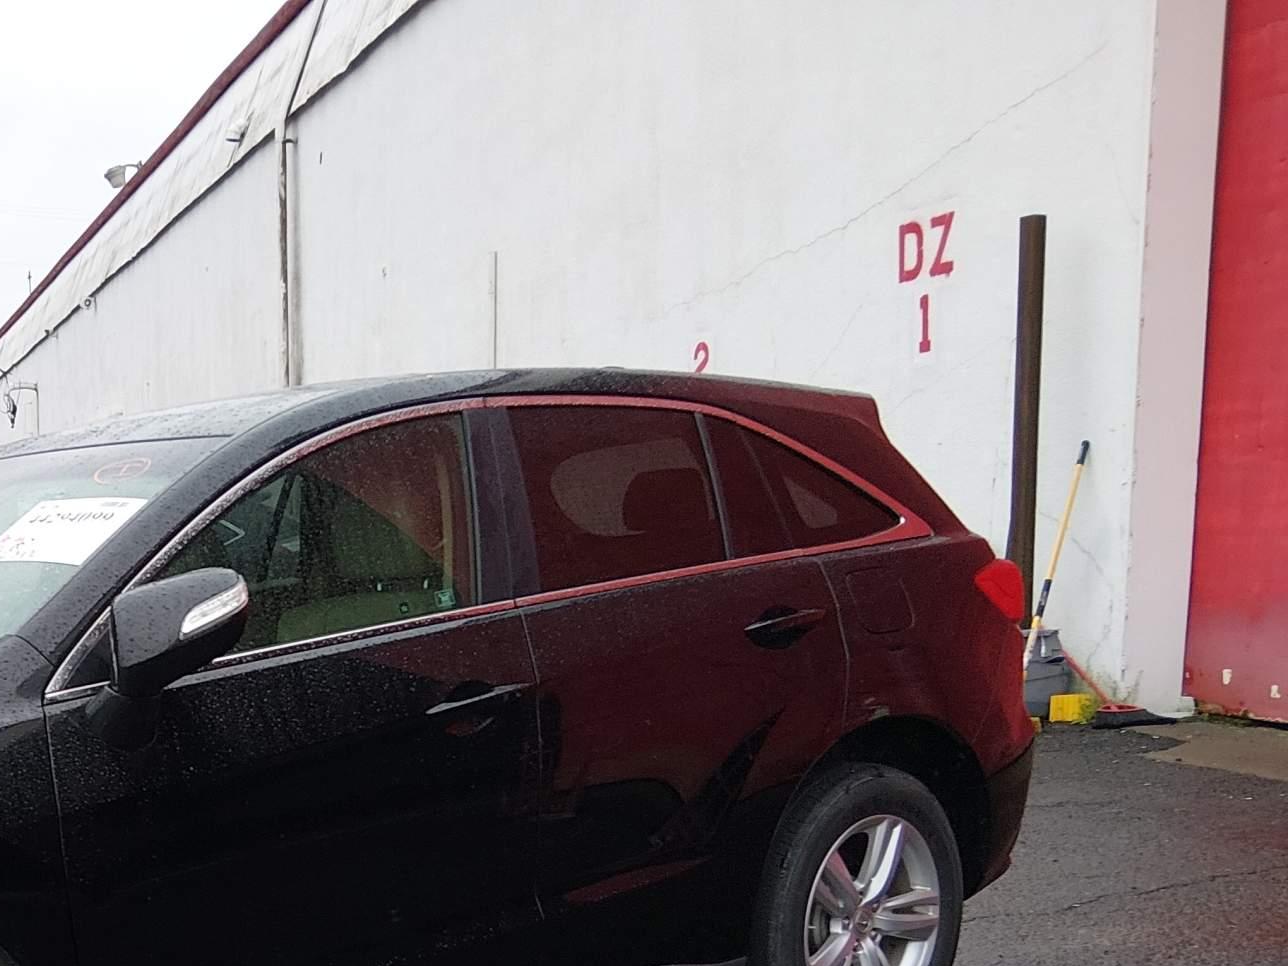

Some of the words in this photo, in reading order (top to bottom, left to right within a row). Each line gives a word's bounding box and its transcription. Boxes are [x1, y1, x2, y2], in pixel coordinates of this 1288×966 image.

[898, 210, 956, 284] DZ
[919, 293, 931, 354] 1
[693, 341, 710, 374] 2
